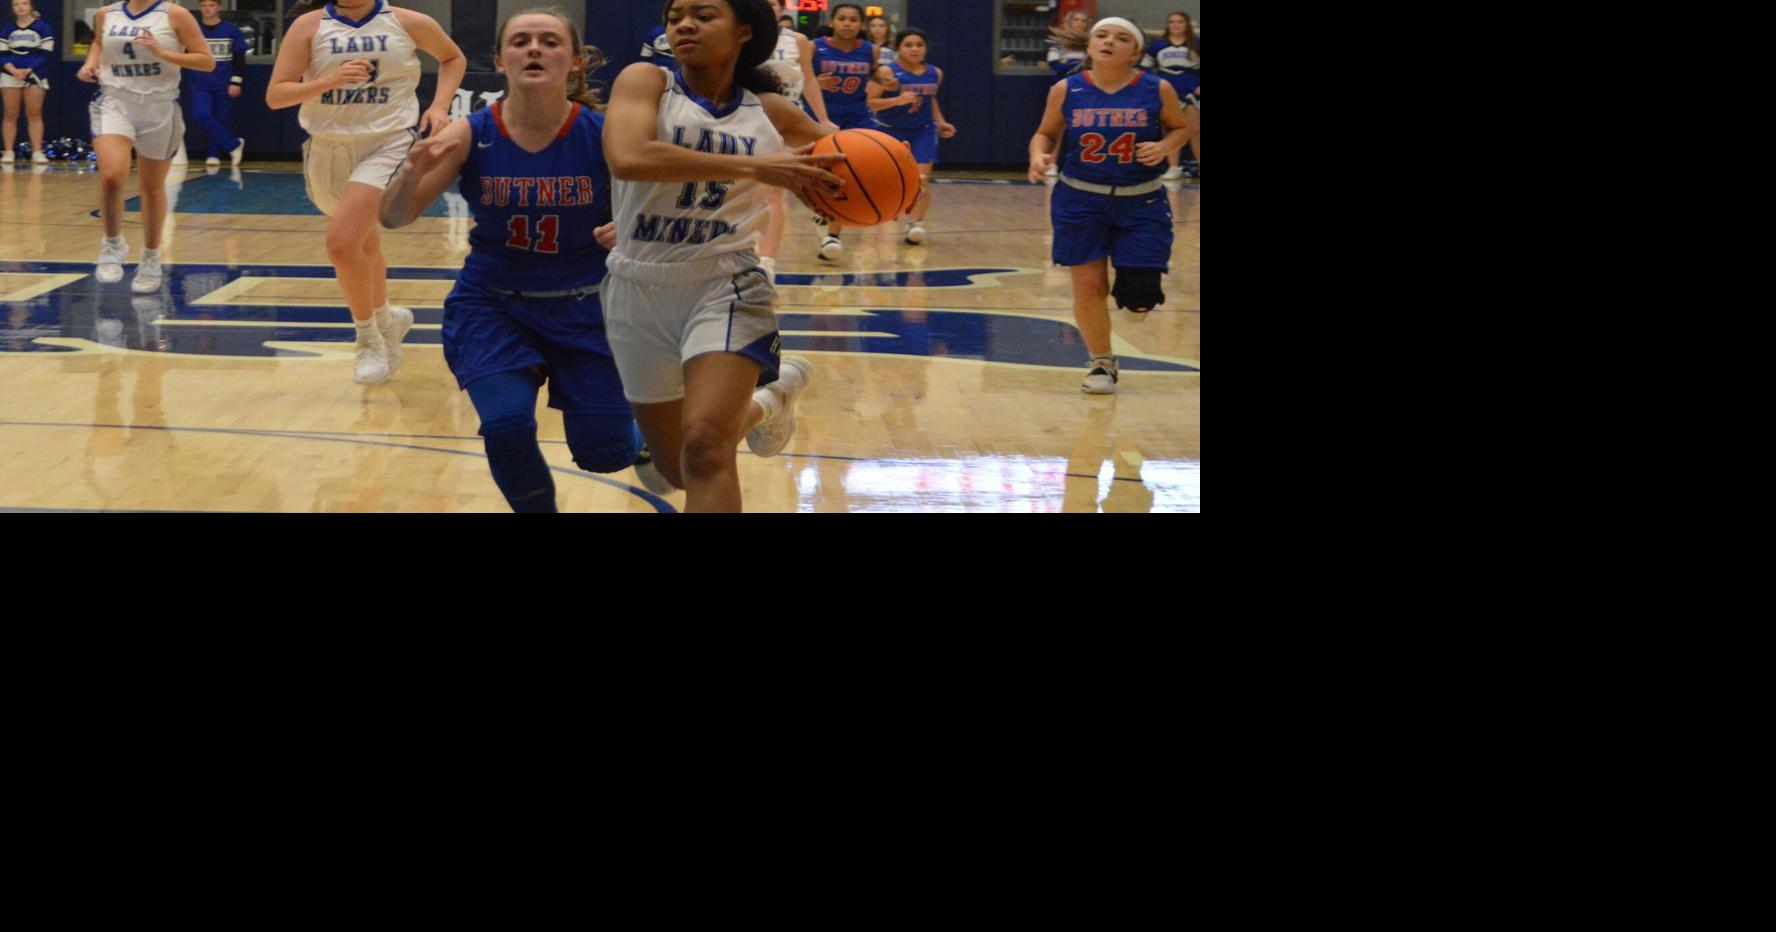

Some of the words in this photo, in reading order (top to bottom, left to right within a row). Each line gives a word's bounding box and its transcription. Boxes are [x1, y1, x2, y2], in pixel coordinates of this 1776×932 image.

[122, 41, 136, 59] 4
[330, 34, 388, 54] LADY
[111, 62, 161, 77] MINERS
[321, 86, 390, 105] MINERS
[1072, 107, 1148, 128] BUTNER
[673, 125, 757, 156] LADY
[1080, 131, 1136, 164] 24
[480, 175, 594, 207] BUTNER
[676, 180, 734, 210] 15
[505, 214, 560, 254] 11
